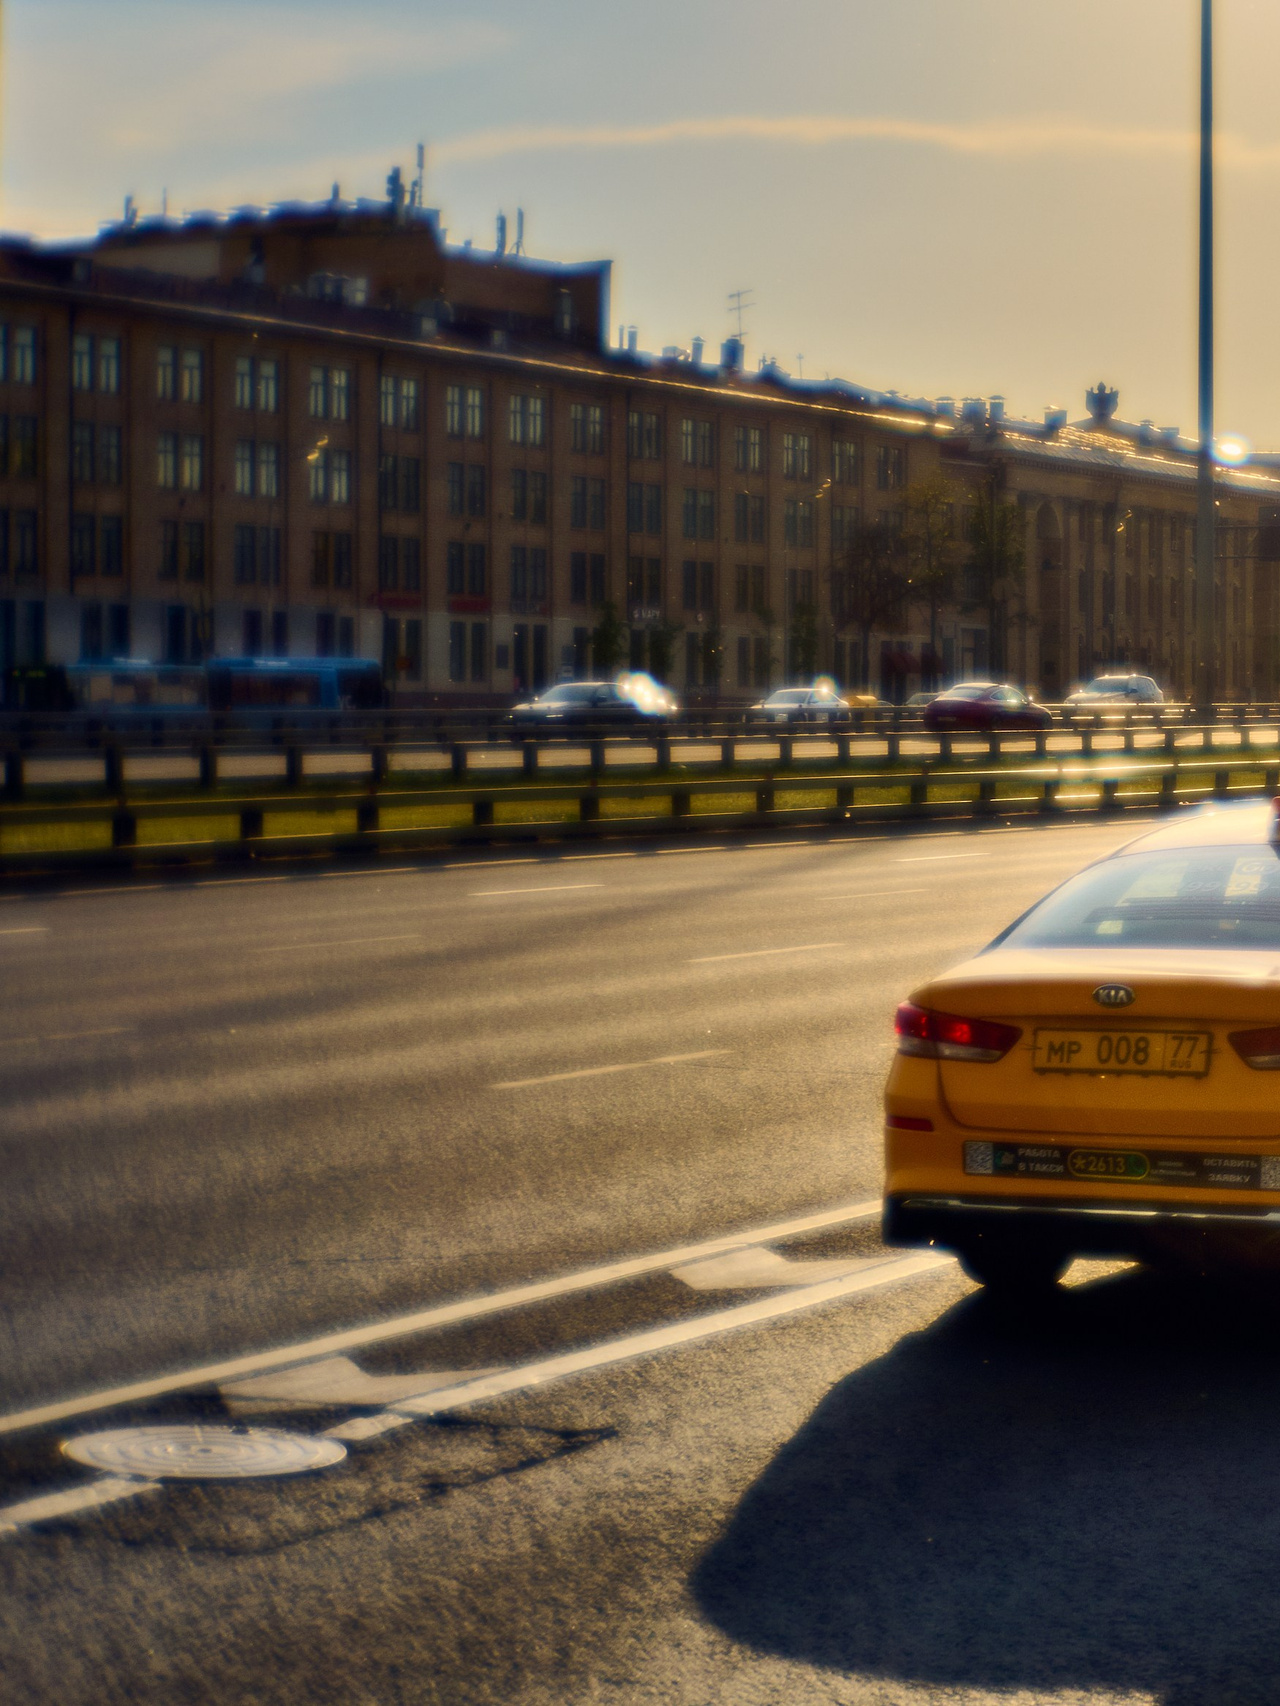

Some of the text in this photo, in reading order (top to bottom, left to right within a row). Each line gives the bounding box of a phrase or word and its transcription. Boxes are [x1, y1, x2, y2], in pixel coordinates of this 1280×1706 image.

[1098, 988, 1128, 1004] KIA
[1096, 1035, 1151, 1066] 008
[1171, 1036, 1200, 1059] 77
[1017, 1147, 1061, 1159] РАБОТА
[1017, 1161, 1065, 1174] В ТАКСИ
[1202, 1157, 1258, 1169] ОСТАВИТЬ
[1207, 1172, 1252, 1184] ЗАЯВКУ
